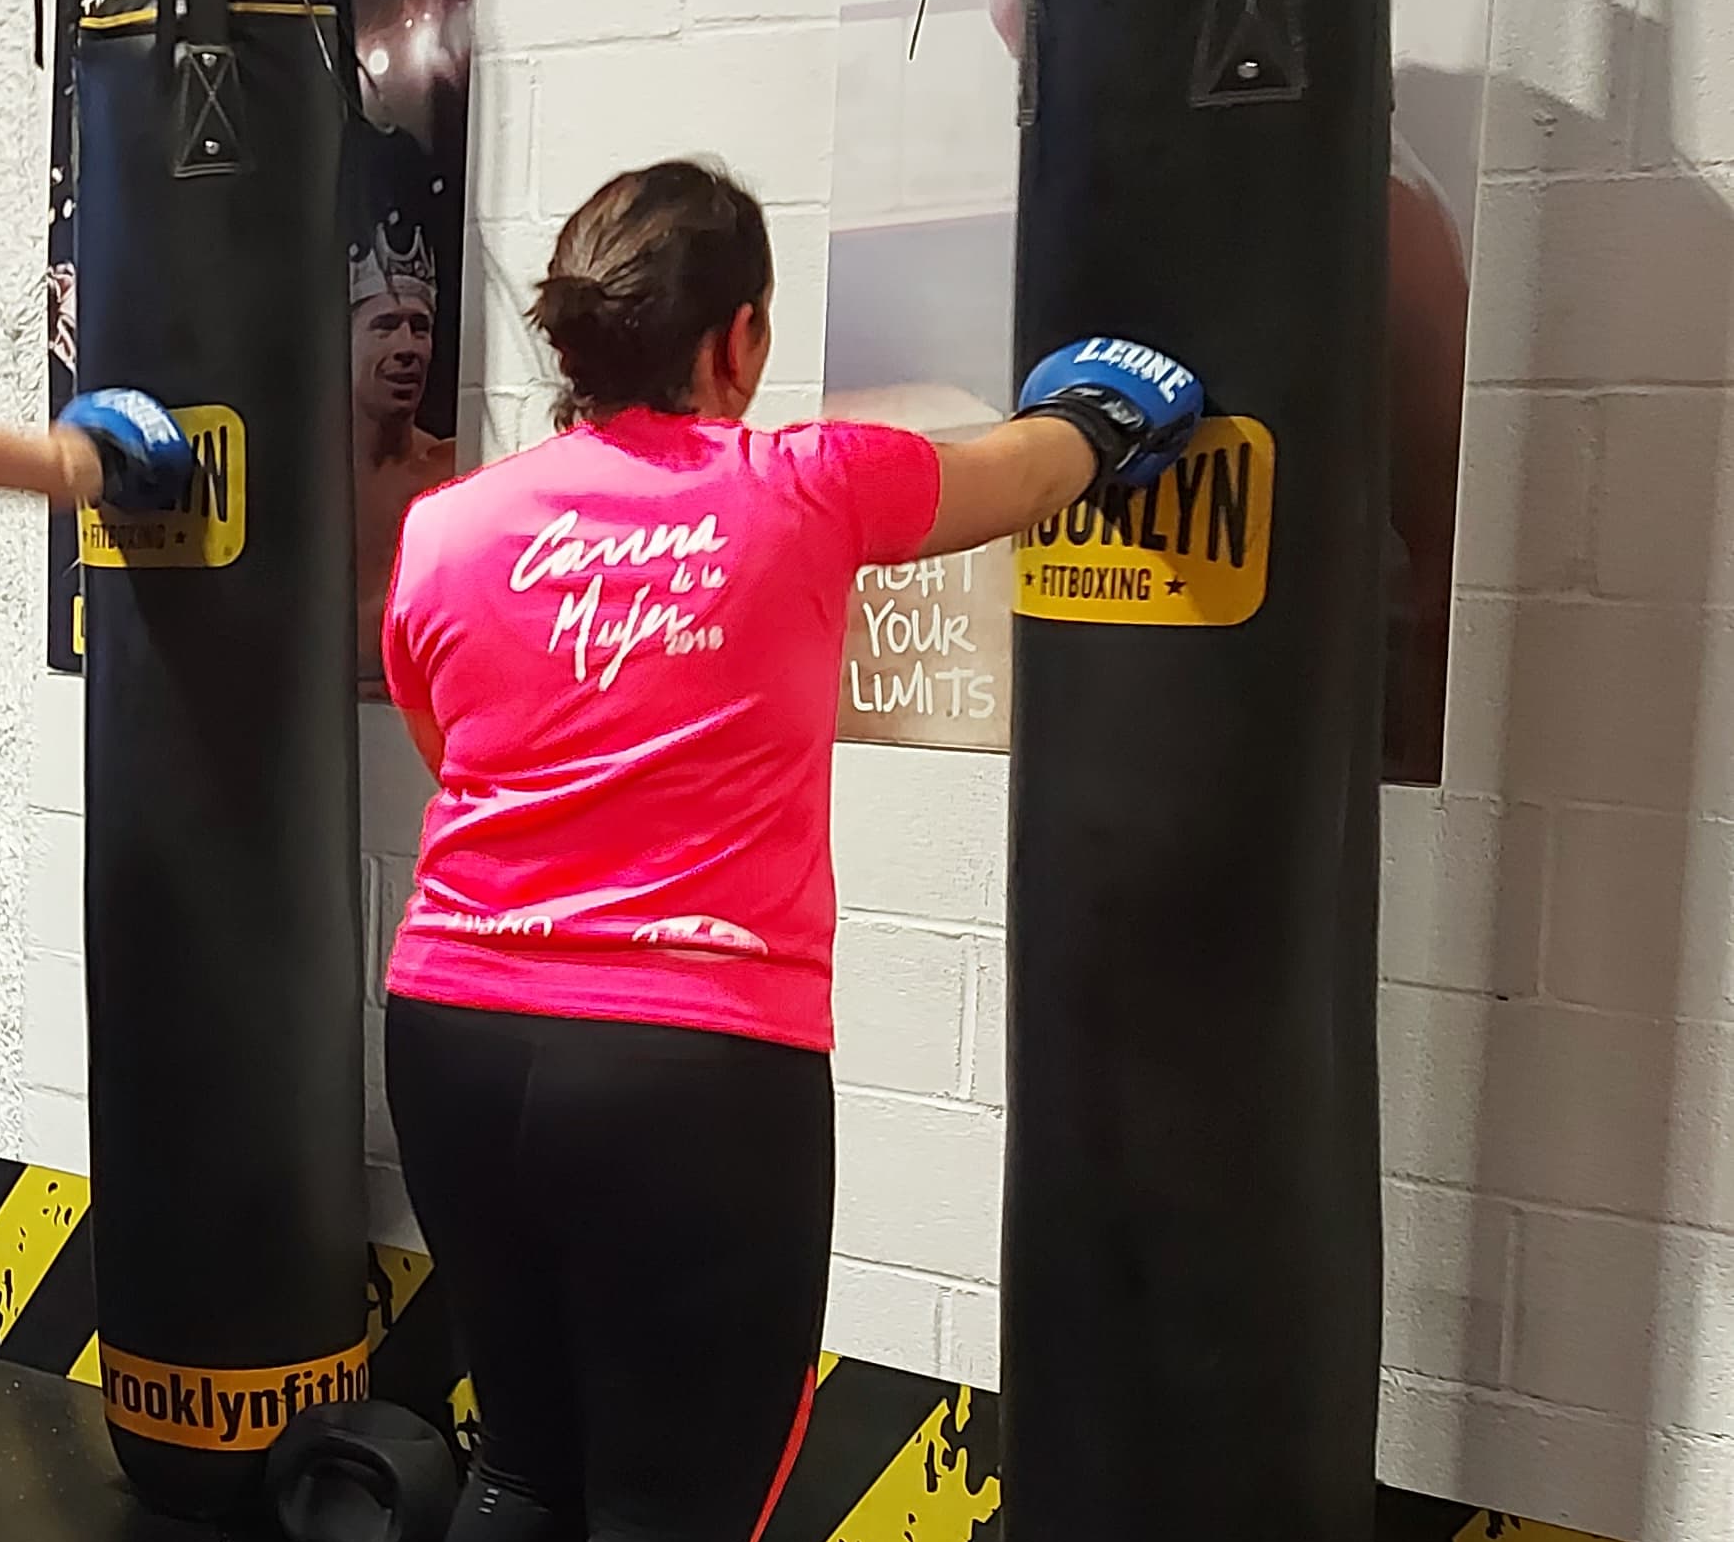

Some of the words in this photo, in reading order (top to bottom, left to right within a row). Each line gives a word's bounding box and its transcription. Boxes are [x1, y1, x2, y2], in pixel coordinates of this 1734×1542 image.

[1074, 337, 1194, 403] LEONE
[1040, 564, 1152, 601] FITBOXING
[862, 599, 977, 658] YOUR
[850, 660, 996, 719] LIMITS
